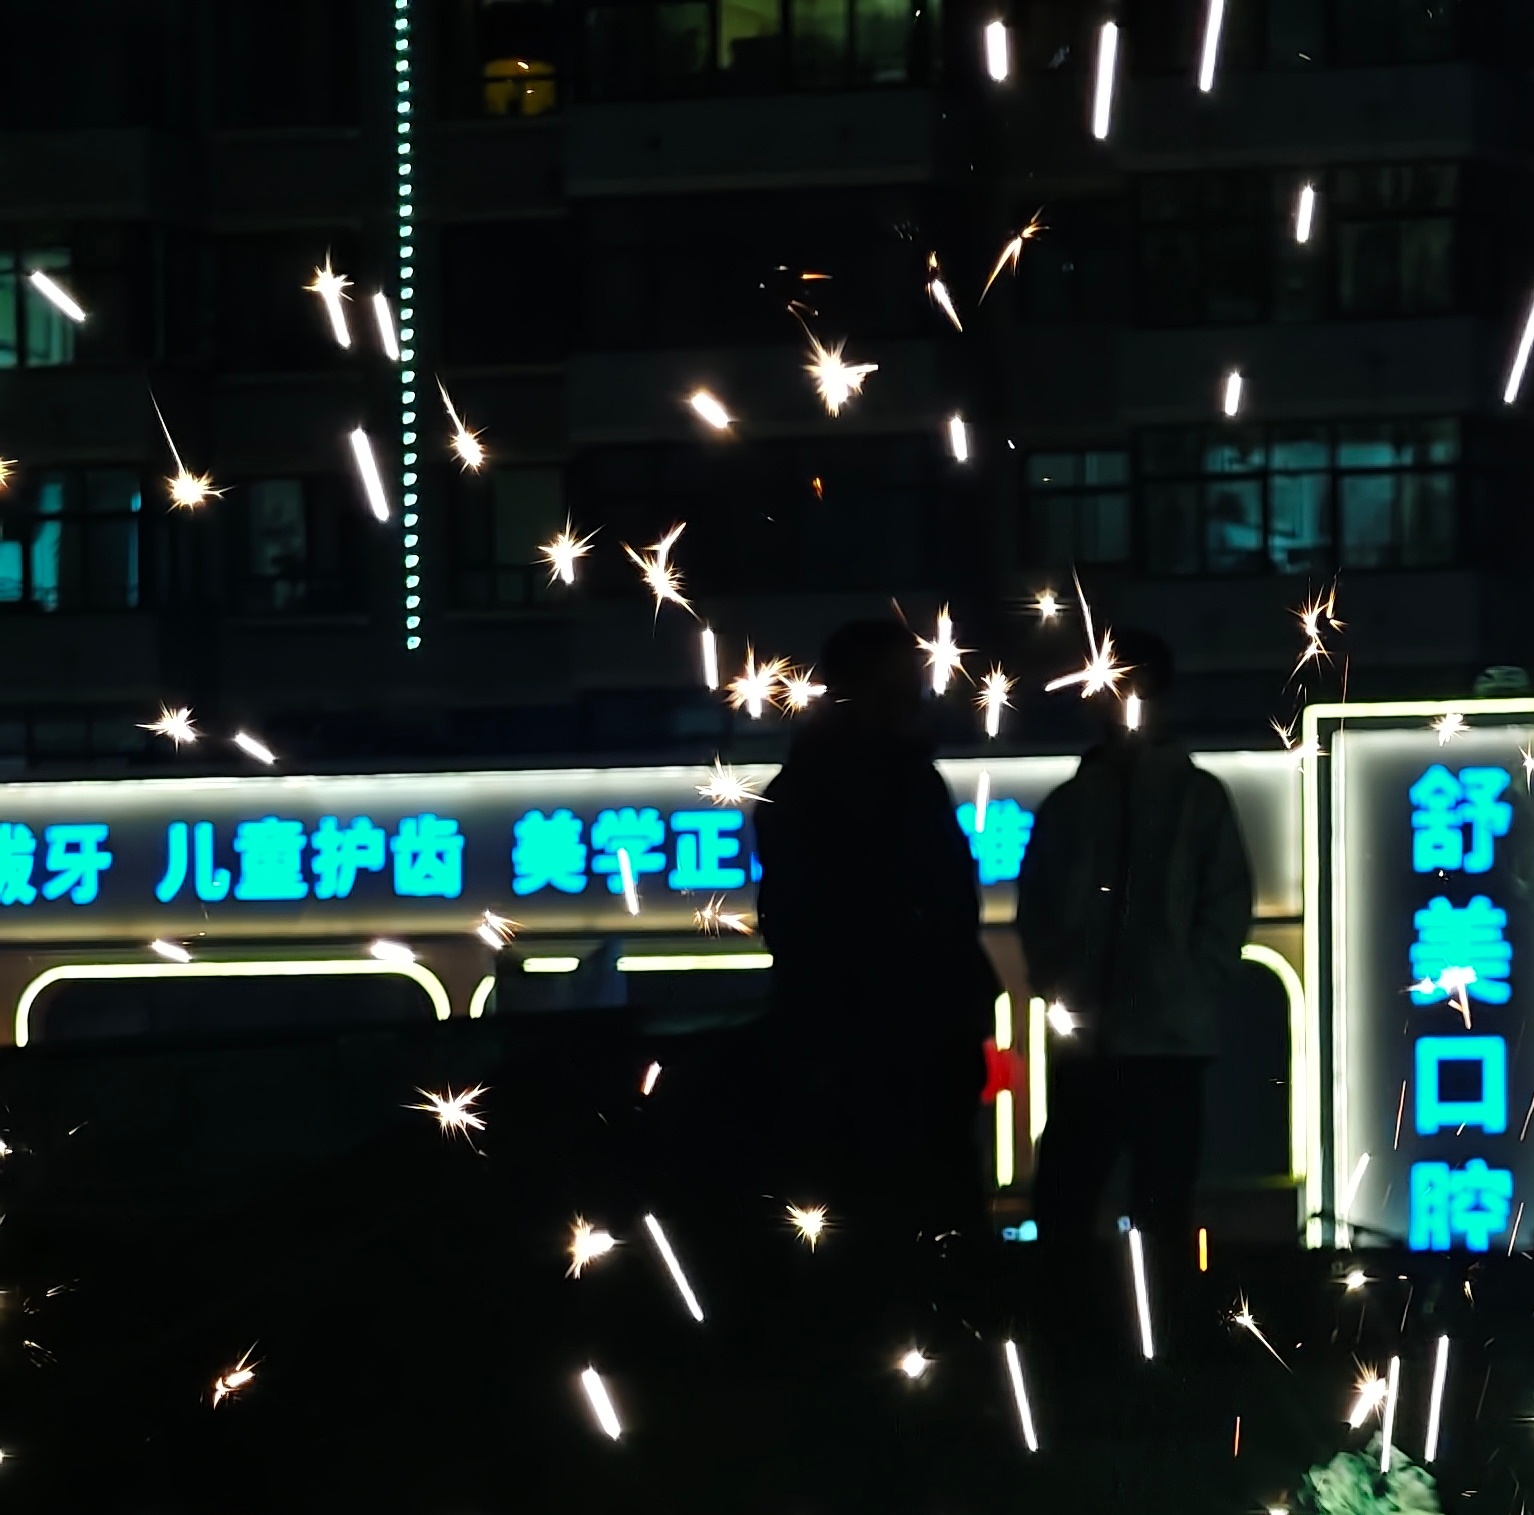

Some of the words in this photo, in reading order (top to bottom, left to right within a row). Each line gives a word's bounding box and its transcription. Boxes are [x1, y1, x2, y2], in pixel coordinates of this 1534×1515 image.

[155, 811, 465, 902] 儿童护齿
[512, 807, 762, 895] 美学正
[1408, 763, 1514, 1252] 舒美口腔
